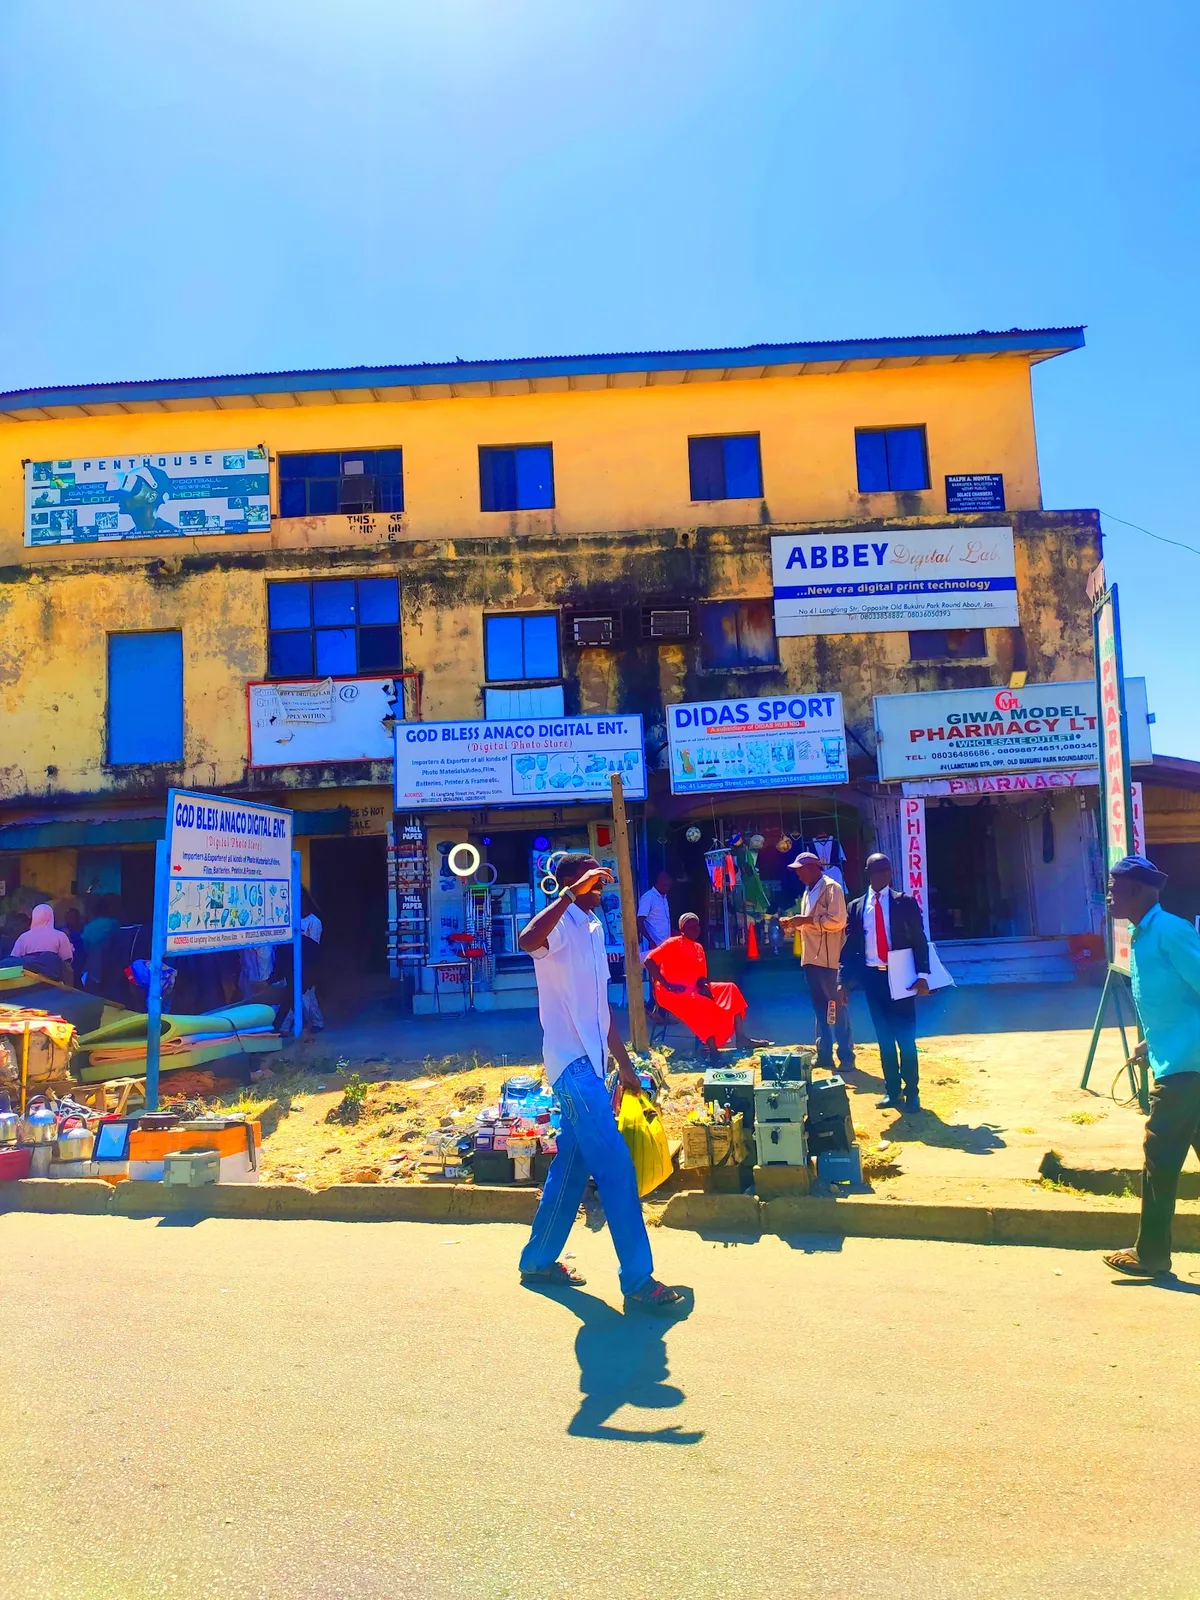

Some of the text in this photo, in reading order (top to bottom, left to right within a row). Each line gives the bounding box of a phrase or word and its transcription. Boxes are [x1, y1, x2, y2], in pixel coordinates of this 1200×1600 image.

[83, 455, 213, 472] PENTHOUSE
[82, 496, 114, 504] LOTS
[347, 515, 370, 524] THIS
[785, 543, 889, 569] ABBEY
[890, 544, 954, 571] Digital
[836, 586, 854, 594] era
[857, 583, 893, 593] digital
[897, 582, 925, 592] print
[927, 580, 991, 591] technology
[862, 604, 889, 613] Opposite
[675, 697, 836, 728] DIDAS SPORT
[946, 705, 1087, 725] GIWA MODEL
[406, 721, 628, 743] GOD BLESS ANACO DIGITAL ENT.
[716, 724, 746, 733] subsidiary
[909, 716, 1097, 743] PHARMACY LT
[467, 738, 573, 753] (Digital Photo Store)
[958, 734, 1071, 747] WHOLESALE OUTLET
[1103, 660, 1123, 842] PHARMACY
[412, 759, 440, 767] Importers
[446, 757, 470, 766] Exporter
[415, 780, 443, 788] Batteries,
[948, 772, 1078, 794] PHARMACY
[361, 808, 369, 818] IS
[371, 806, 386, 817] NOT
[176, 802, 286, 839] GOD BLESS ANACO DIGITAL ENT.
[231, 837, 247, 849] Photo
[182, 851, 204, 861] Importers
[906, 800, 923, 914] PHARMA
